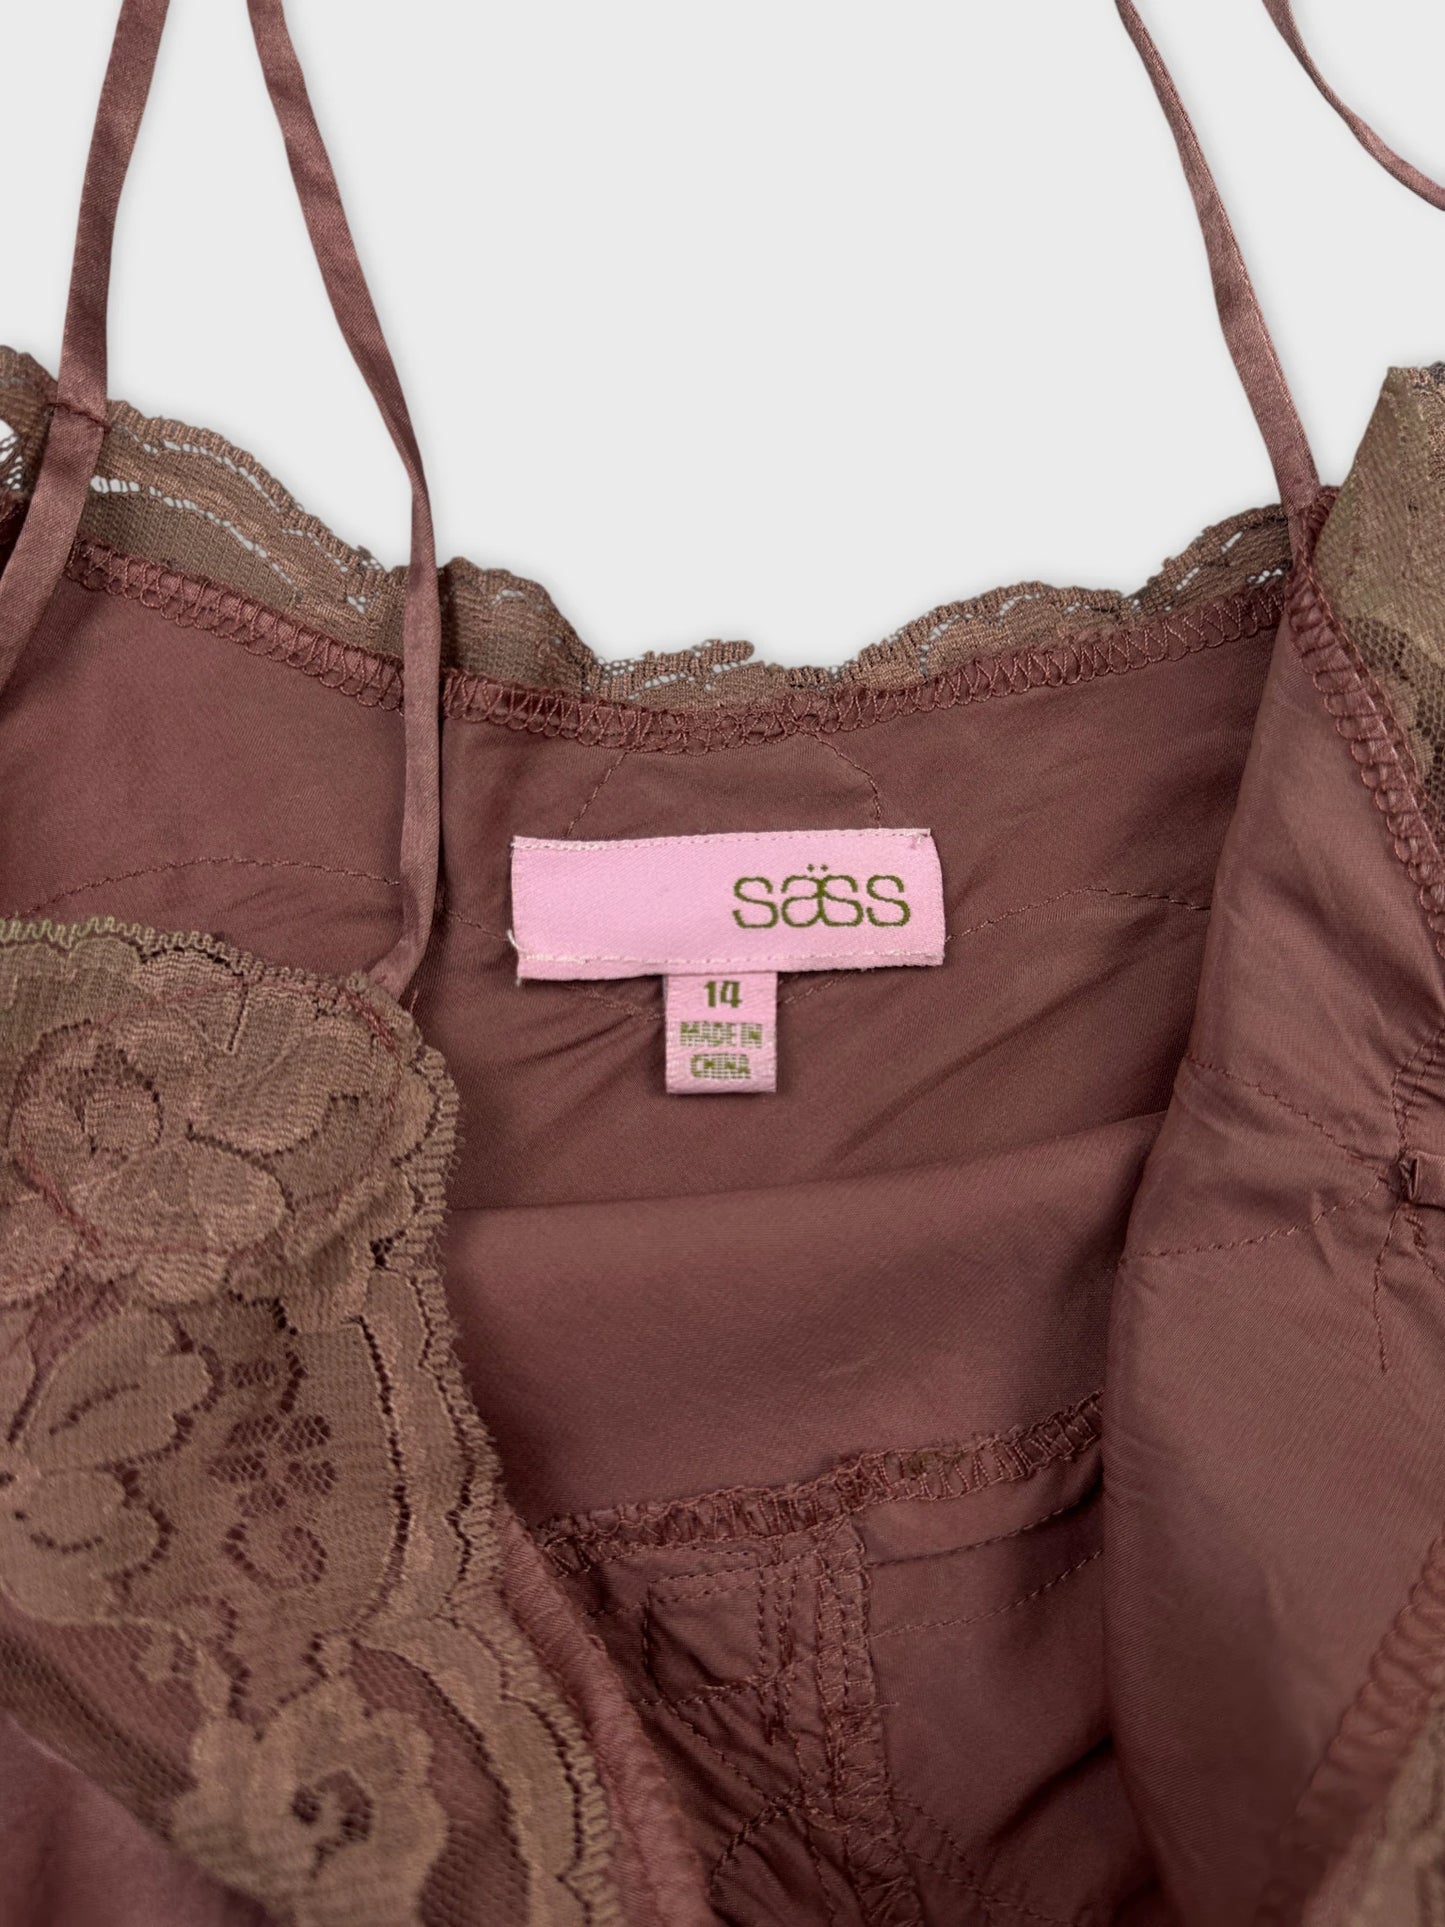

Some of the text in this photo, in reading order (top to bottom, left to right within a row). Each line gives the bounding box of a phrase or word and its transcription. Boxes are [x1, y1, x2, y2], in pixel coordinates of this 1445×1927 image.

[732, 863, 911, 929] säss
[704, 980, 743, 1008] 14
[679, 1020, 763, 1049] MADE IN
[690, 1053, 751, 1079] CHINA
